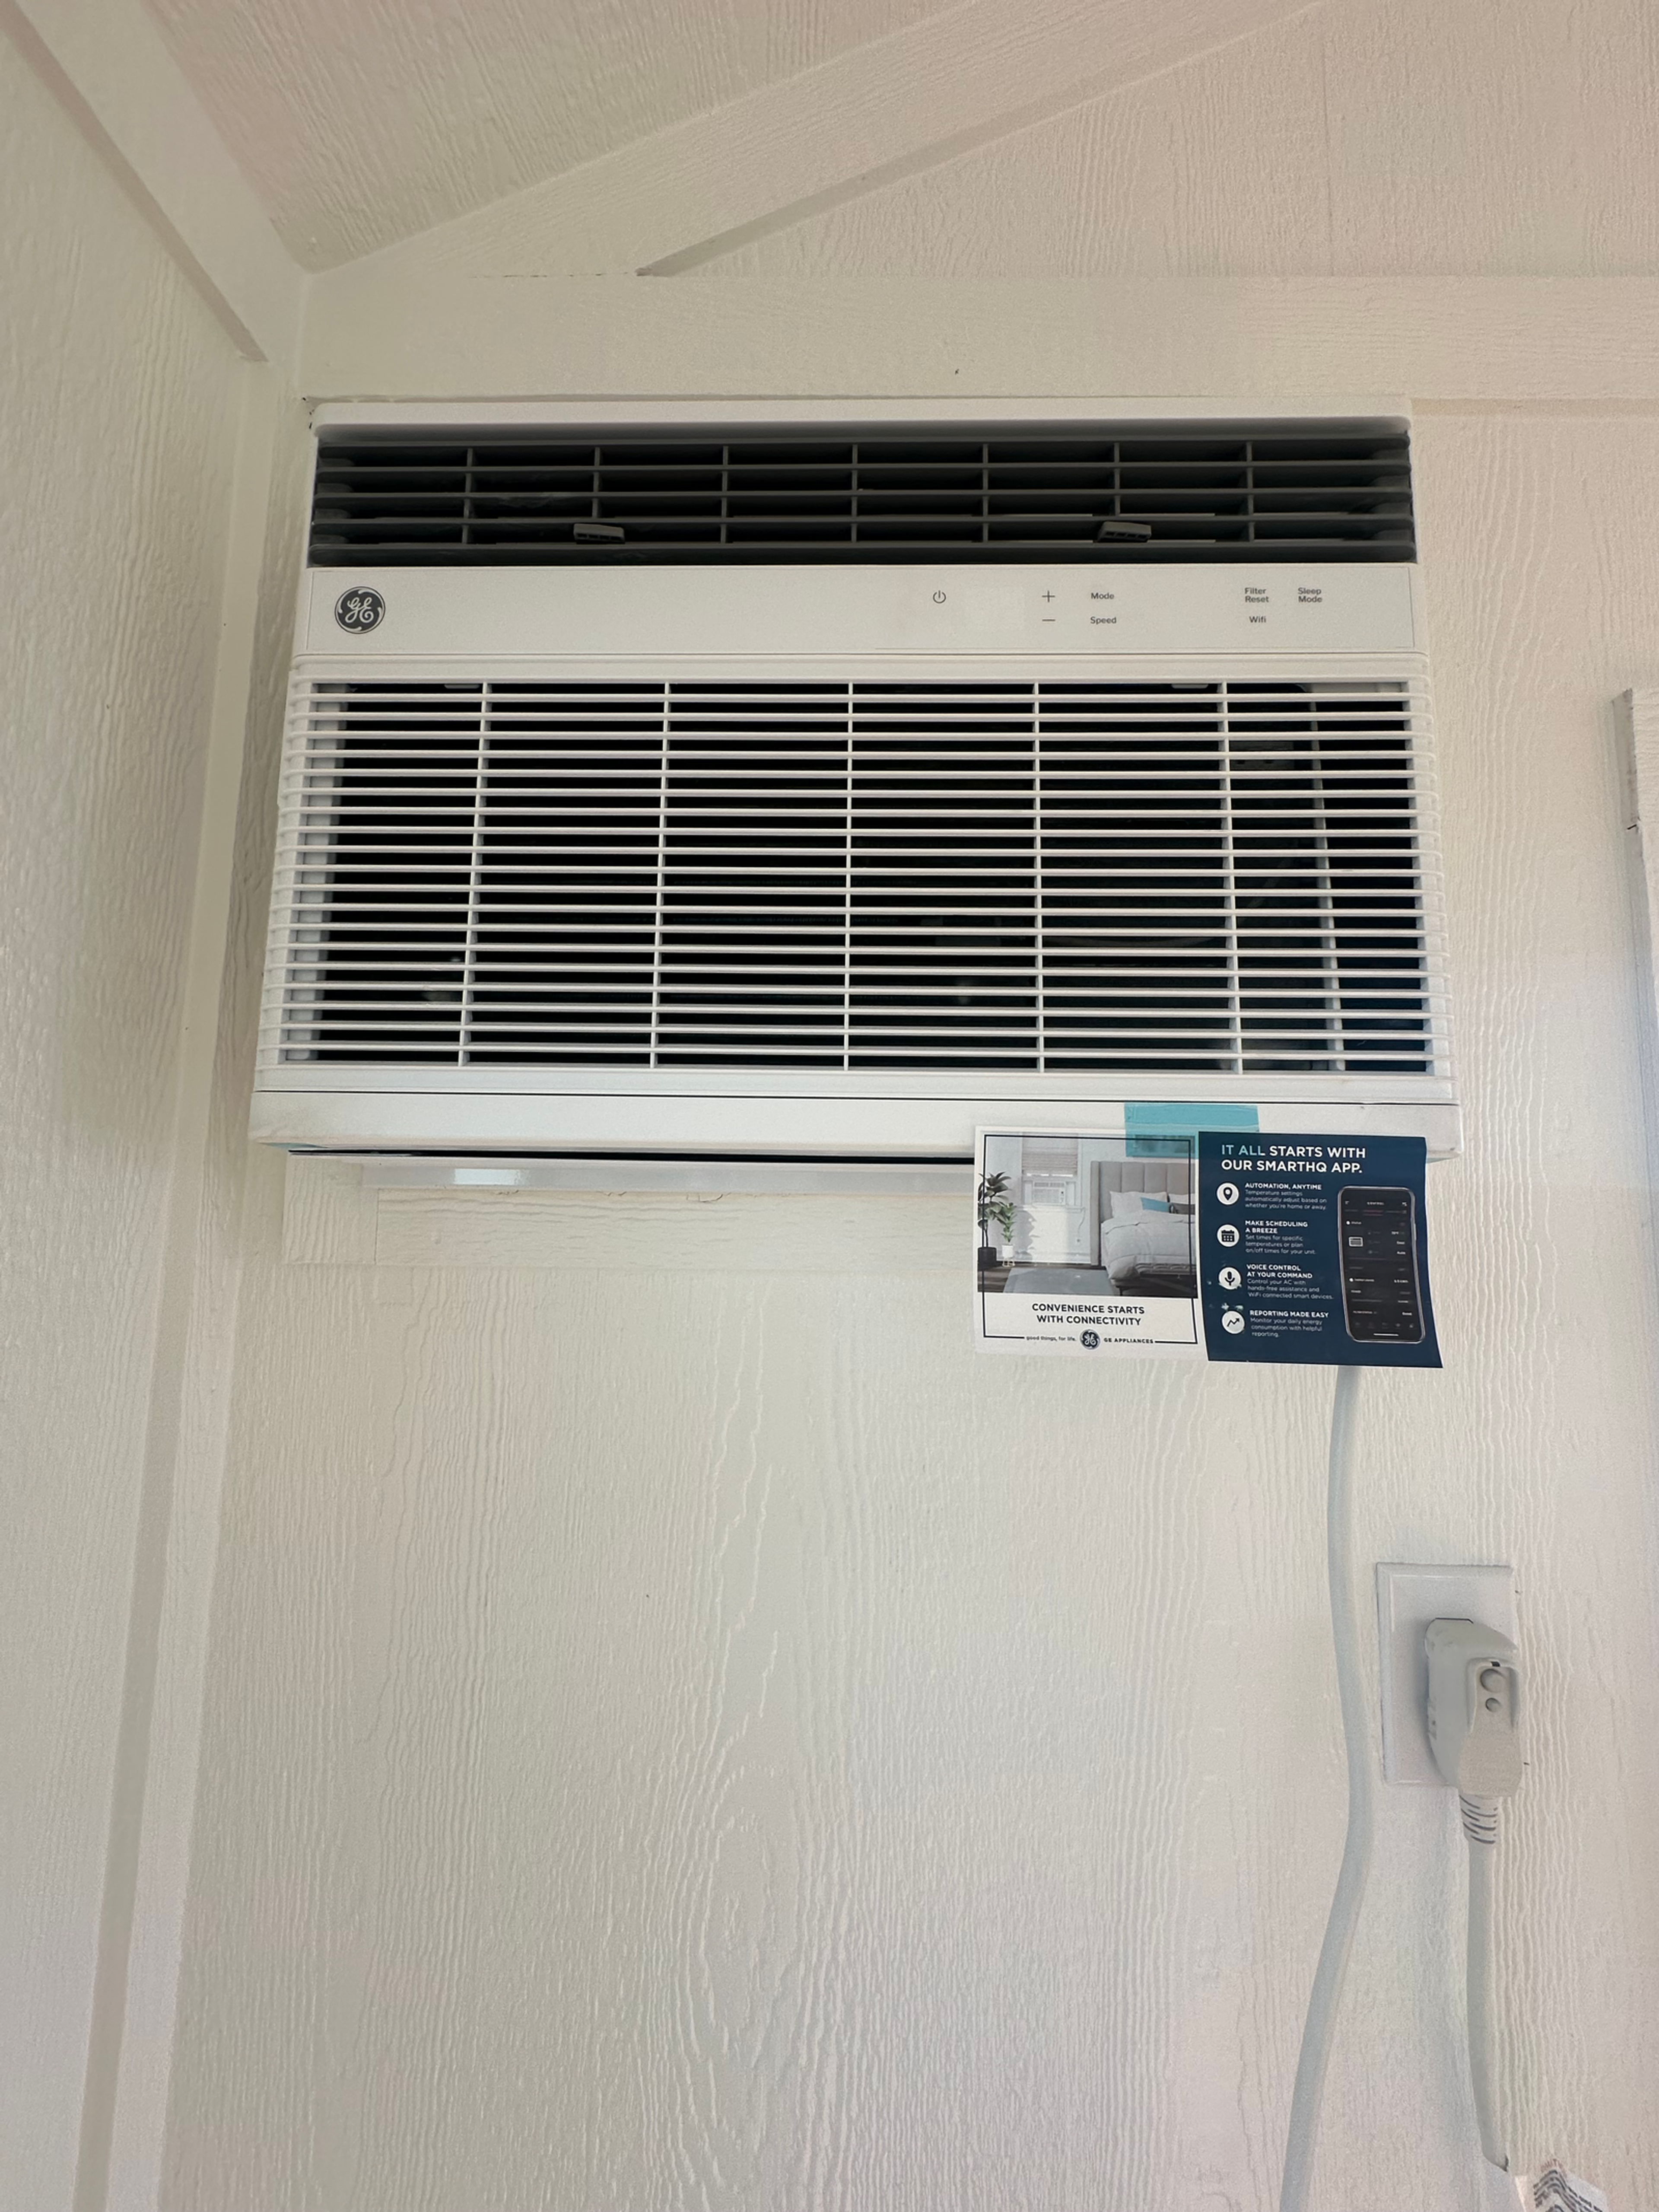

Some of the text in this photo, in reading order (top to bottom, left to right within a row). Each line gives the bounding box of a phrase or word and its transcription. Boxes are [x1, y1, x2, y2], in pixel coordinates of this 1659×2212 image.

[1298, 587, 1322, 595] Sleep
[1090, 616, 1117, 625] Speed
[1221, 1145, 1366, 1158] IT ALL STARTS WITH
[1221, 1159, 1362, 1173] OUR SMARTHQ APP.
[1032, 1303, 1144, 1314] CONVENIENCE STARTS
[1036, 1315, 1141, 1325] WITH CONNECTIVITY
